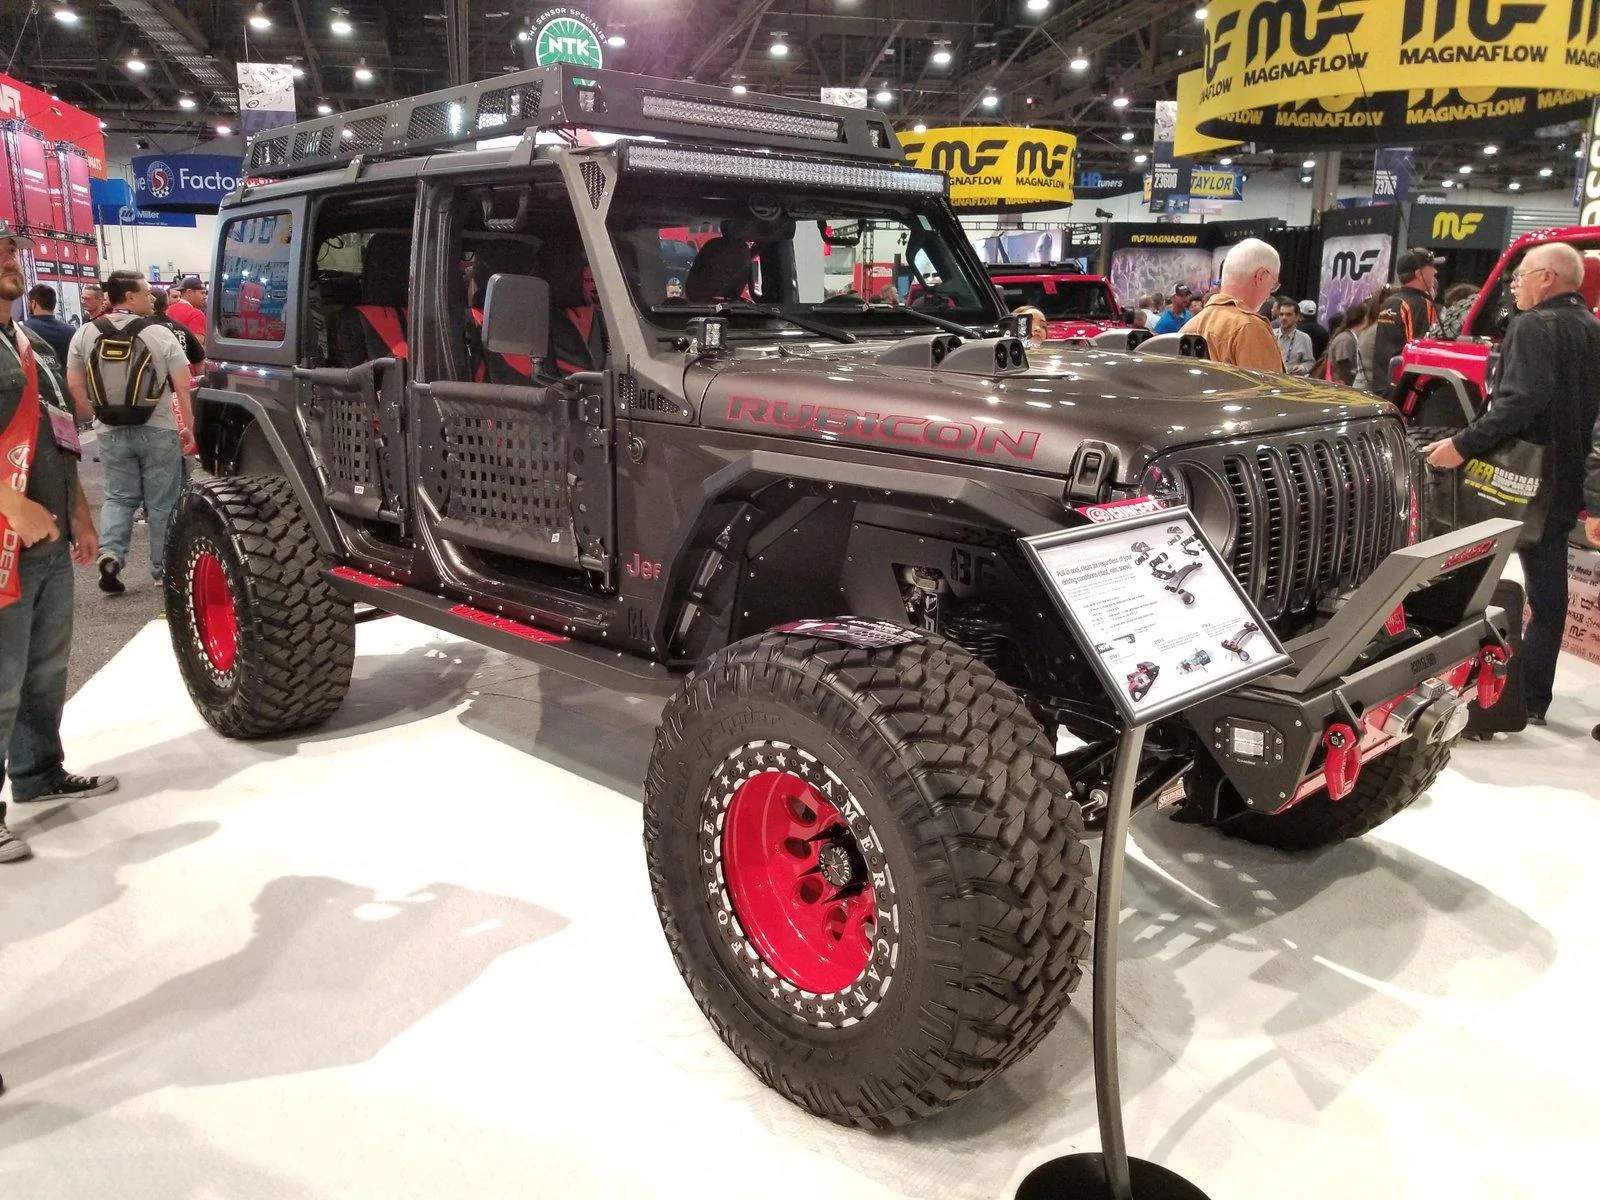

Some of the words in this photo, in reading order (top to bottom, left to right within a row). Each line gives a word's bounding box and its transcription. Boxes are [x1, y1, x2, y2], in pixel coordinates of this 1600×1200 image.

[527, 25, 538, 41] THE
[536, 7, 567, 25] SENSOR
[569, 8, 608, 45] SPECIALIST
[548, 36, 590, 57] NTK
[1399, 45, 1549, 66] MAGNAFLOW
[1244, 51, 1369, 88] MAGNAFLOW
[1275, 111, 1385, 128] MAGNAFLOW
[1406, 97, 1527, 125] MAGNAFLOW
[179, 168, 244, 191] Factor
[949, 176, 1003, 186] GNAFLOW
[1016, 176, 1065, 189] MAGNAFLOW
[1097, 178, 1123, 188] tuners
[1190, 173, 1232, 192] TAYLOR
[1347, 218, 1372, 226] LIVE
[1145, 235, 1198, 244] MAGNAFLOW
[726, 395, 1041, 461] RUBICON
[1494, 466, 1540, 486] ORIGINAL
[704, 820, 743, 955] FORCE
[821, 779, 890, 1007] AMERICAN
